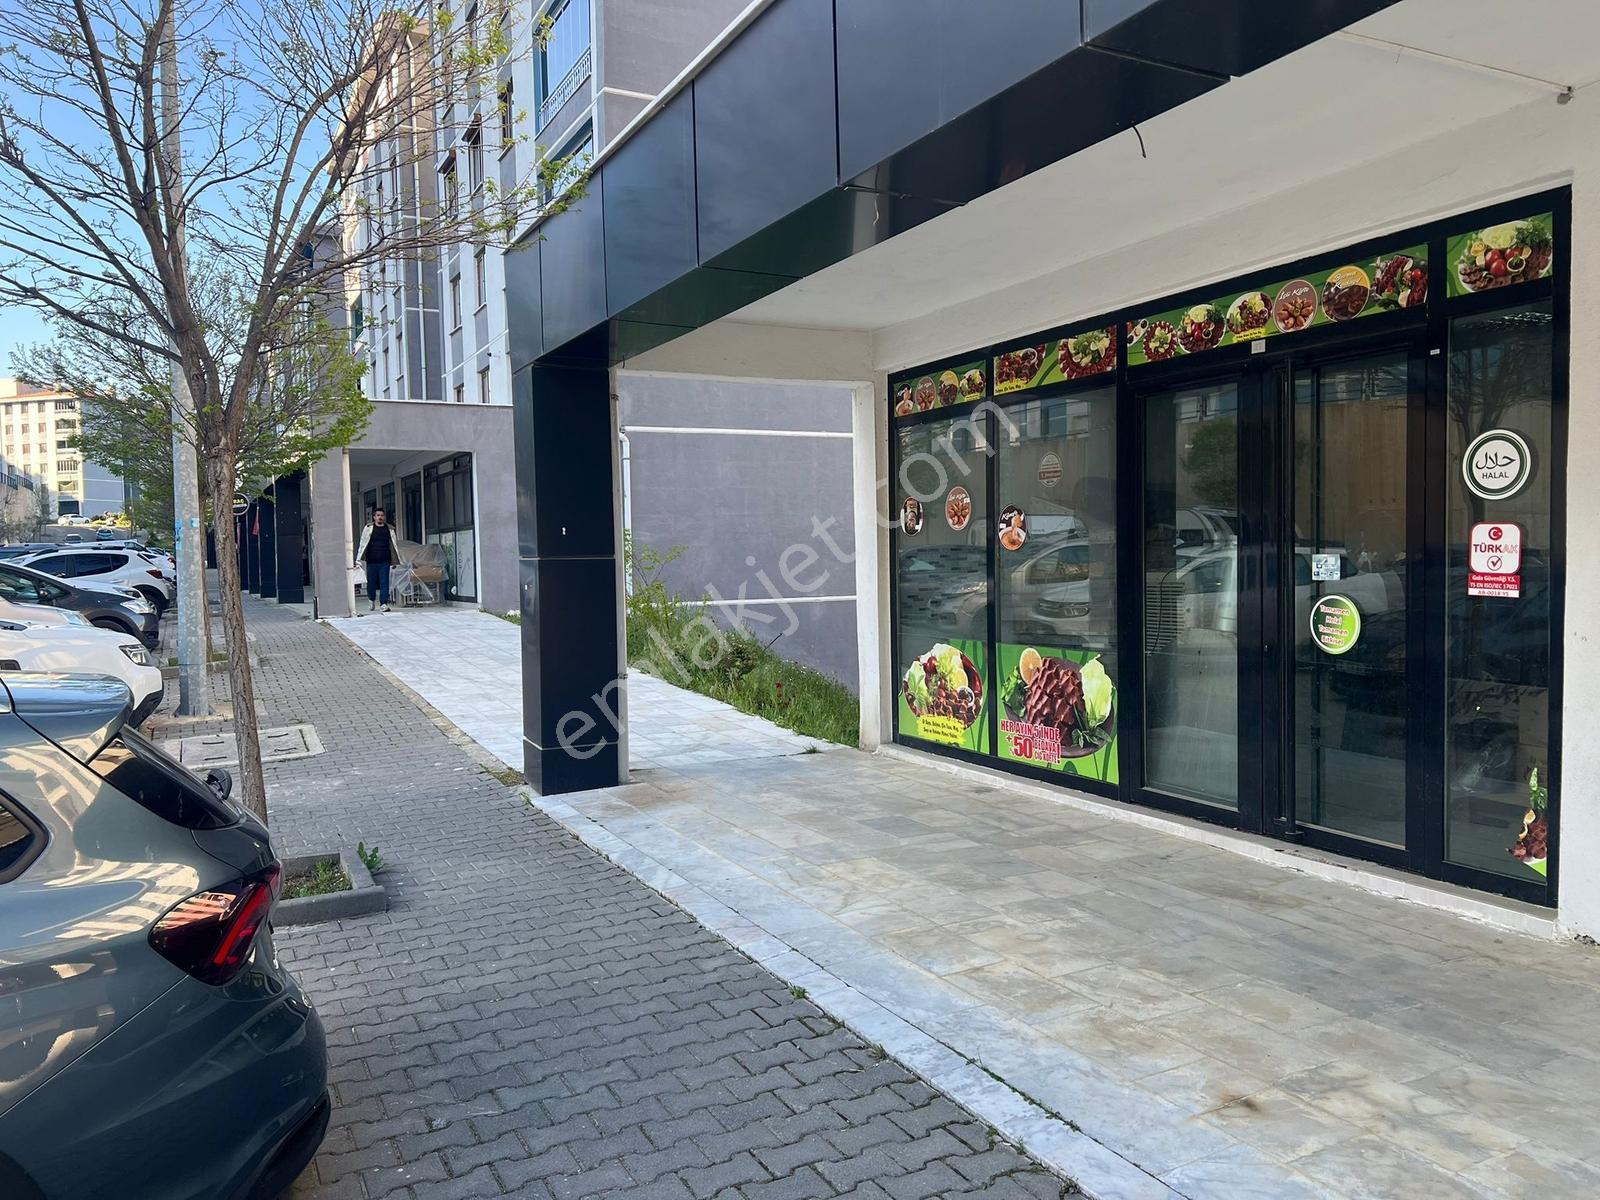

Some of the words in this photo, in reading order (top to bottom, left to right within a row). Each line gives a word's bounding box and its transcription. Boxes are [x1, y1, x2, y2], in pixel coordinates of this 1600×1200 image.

[1475, 451, 1517, 470] حلال
[1481, 471, 1510, 480] HALAL
[1473, 542, 1518, 554] TÜRKAK
[1320, 605, 1350, 616] Tamamen
[1318, 625, 1349, 637] Tamamen
[1321, 635, 1344, 645] Bitkisel
[1001, 719, 1014, 733] HER
[1014, 721, 1034, 737] AYIN
